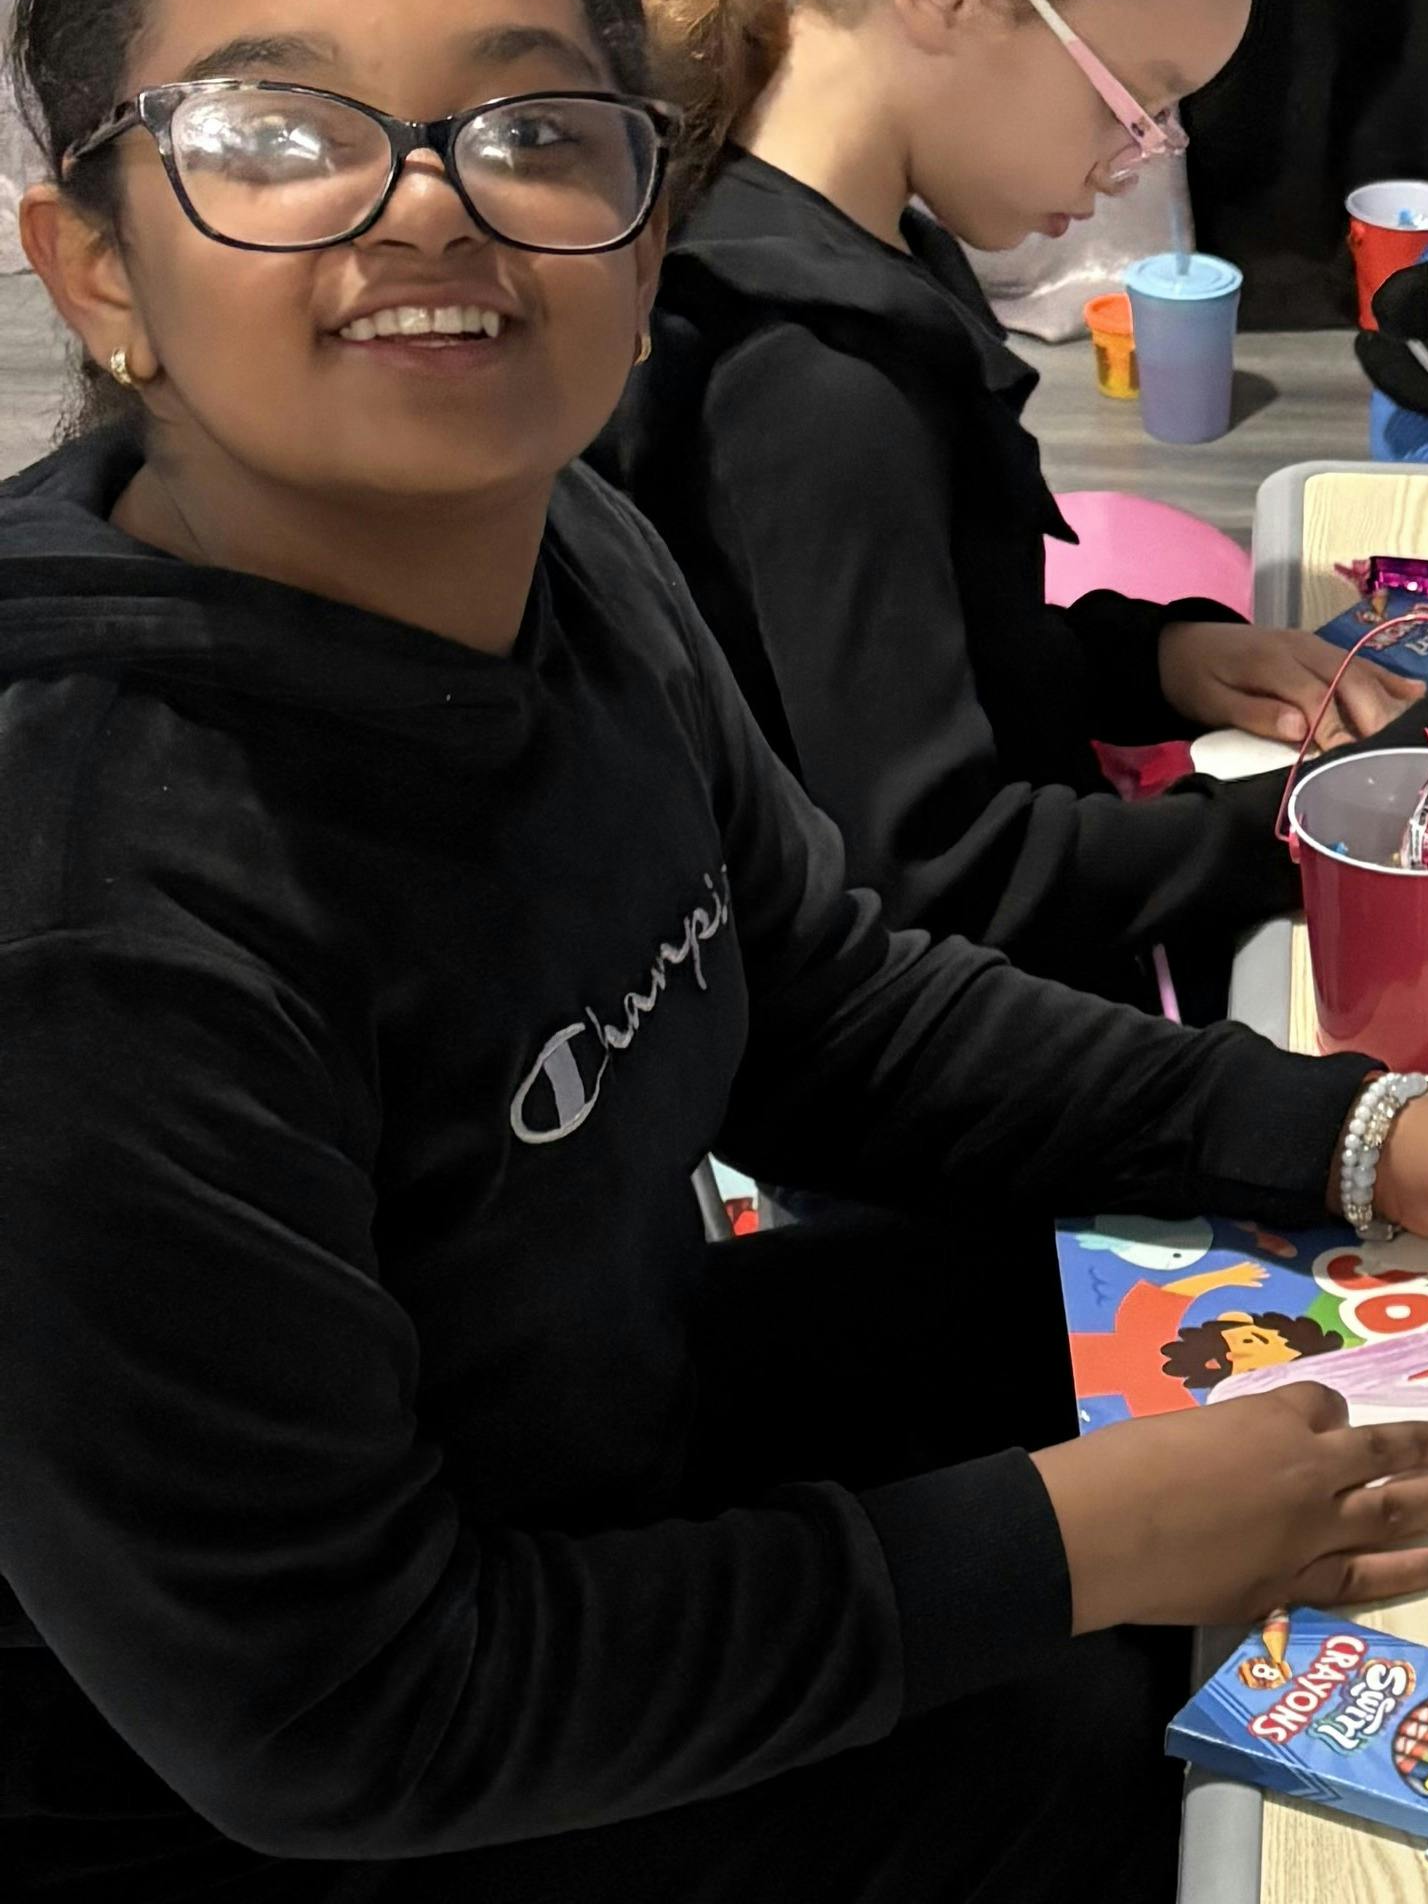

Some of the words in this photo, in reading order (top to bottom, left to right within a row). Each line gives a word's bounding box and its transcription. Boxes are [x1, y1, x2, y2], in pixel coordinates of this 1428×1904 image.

[510, 864, 729, 1144] Champi
[1250, 1634, 1366, 1744] CRAYONS
[1251, 1663, 1278, 1681] 8
[1318, 1661, 1407, 1752] Swirl
